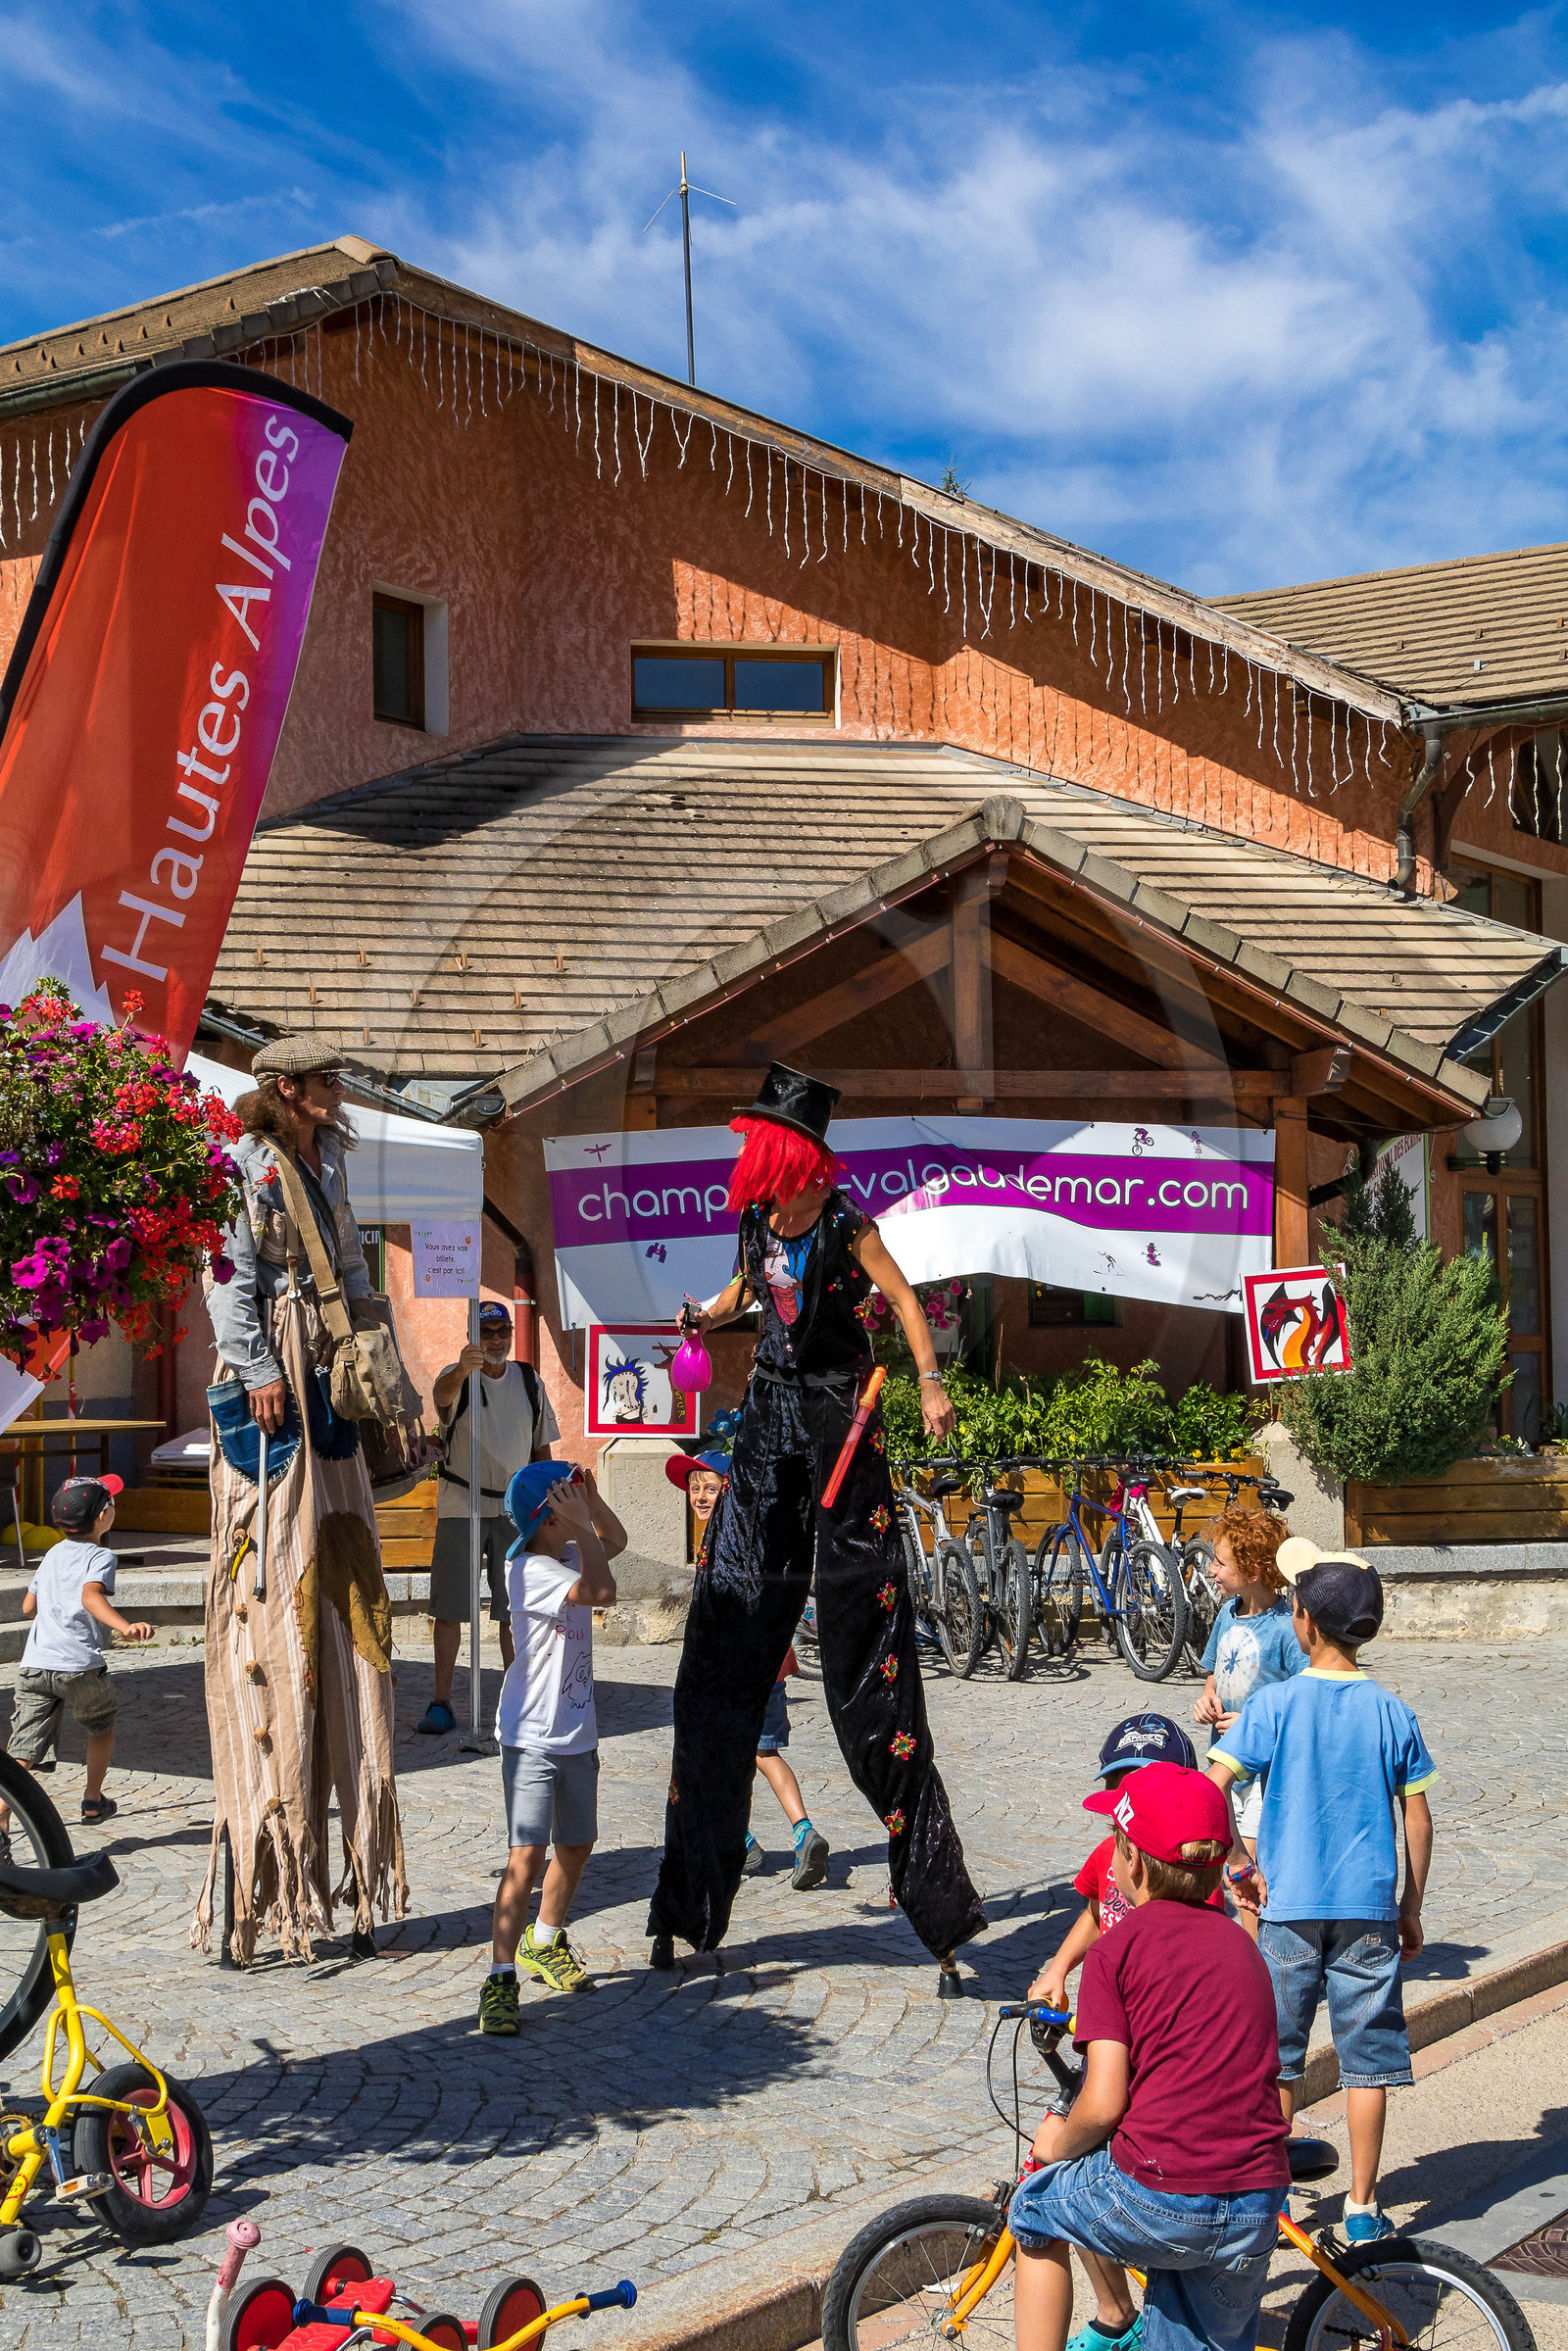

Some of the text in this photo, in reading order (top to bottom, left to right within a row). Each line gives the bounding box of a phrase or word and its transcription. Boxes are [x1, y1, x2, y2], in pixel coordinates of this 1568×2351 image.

[100, 414, 301, 983] Hautes Alpes
[578, 1158, 1250, 1223] champ-valgaudemar.com
[674, 1390, 686, 1419] UTUR
[1115, 1731, 1165, 1750] RAPACES
